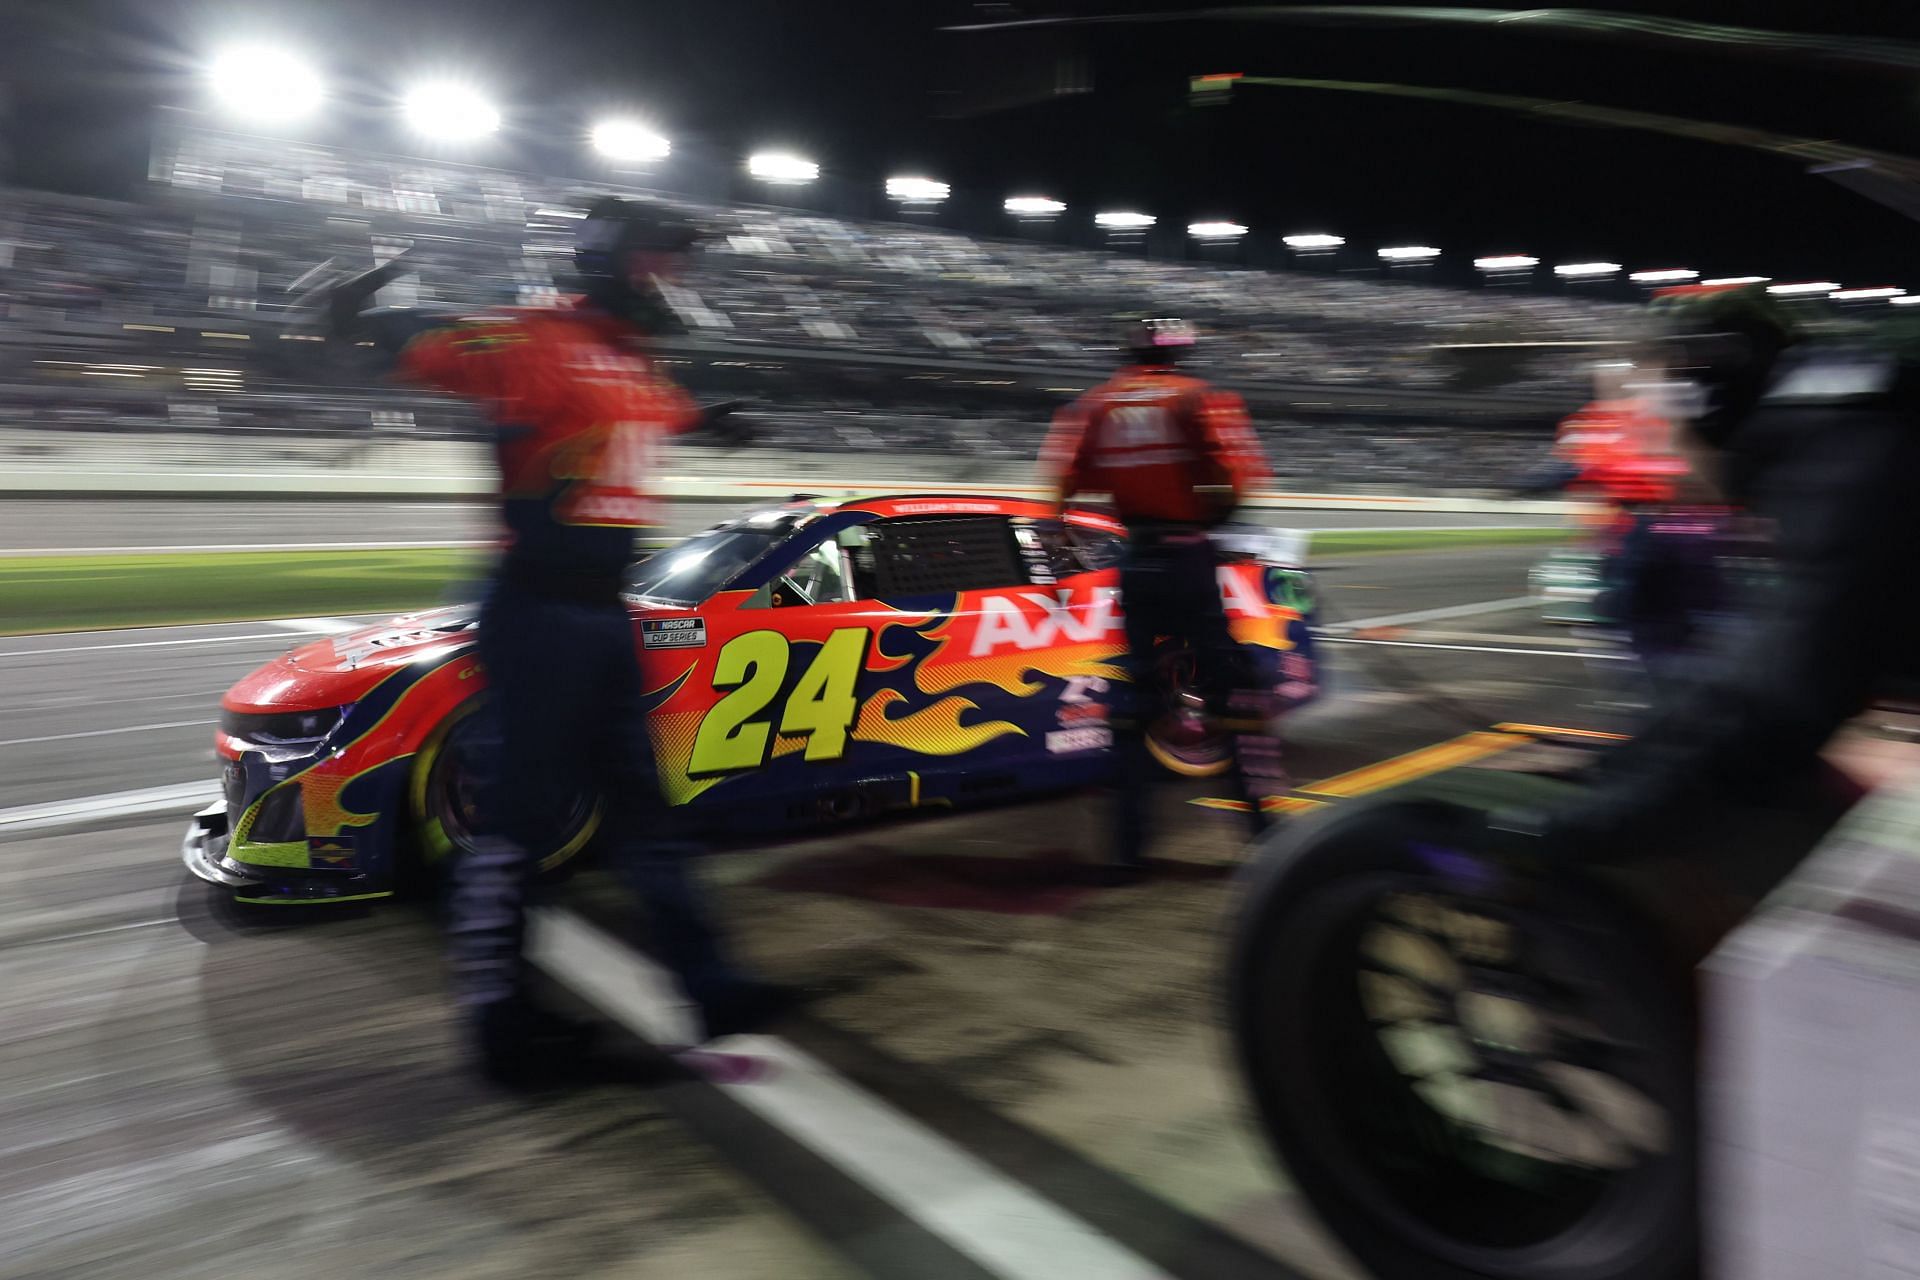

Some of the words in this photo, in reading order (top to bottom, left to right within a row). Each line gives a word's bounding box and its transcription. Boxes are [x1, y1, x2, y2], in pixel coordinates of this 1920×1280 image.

[662, 620, 695, 630] NASCAR
[653, 633, 669, 642] CUP
[669, 632, 698, 642] SERIES
[687, 627, 870, 776] 24
